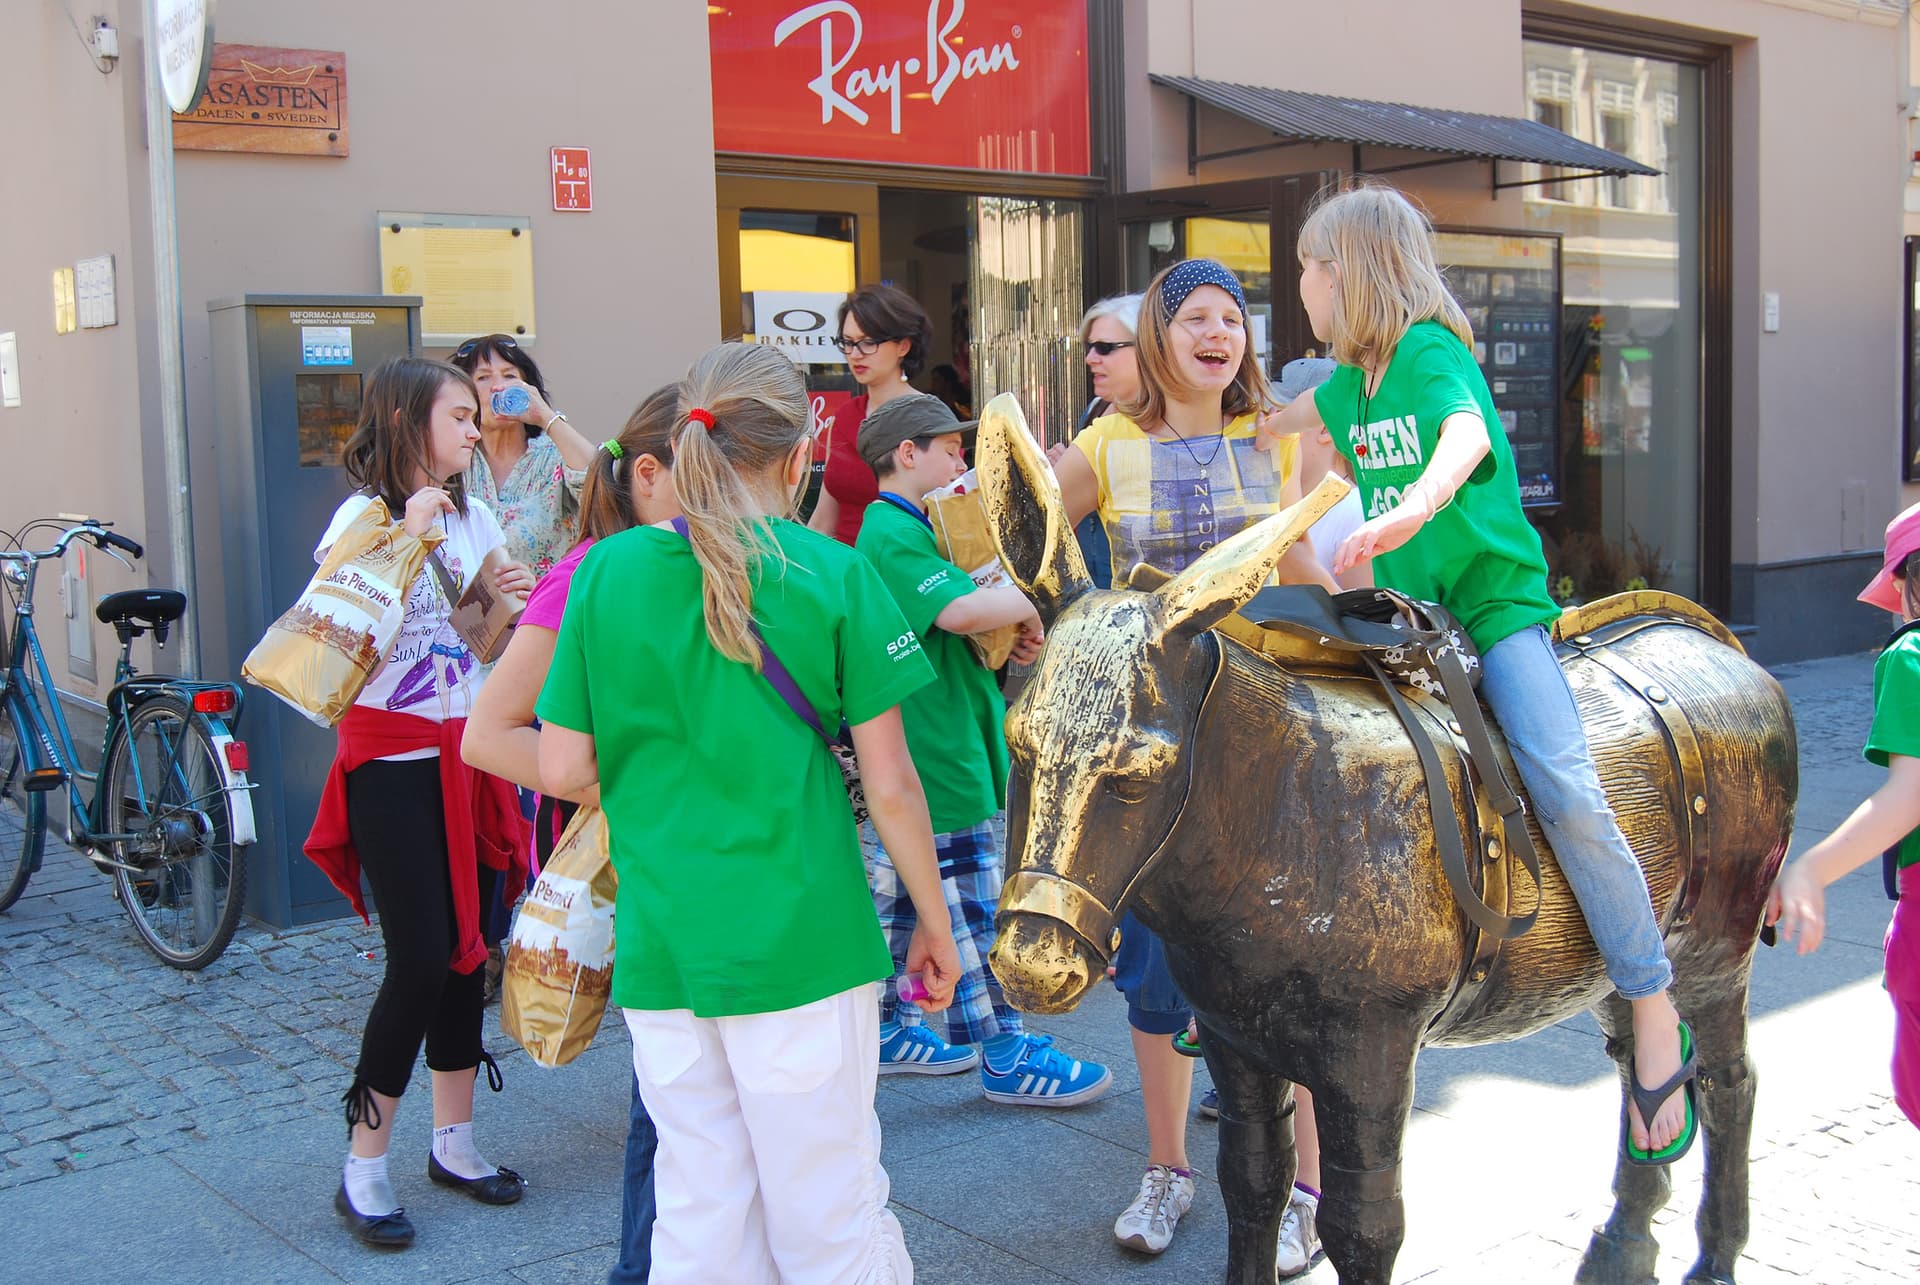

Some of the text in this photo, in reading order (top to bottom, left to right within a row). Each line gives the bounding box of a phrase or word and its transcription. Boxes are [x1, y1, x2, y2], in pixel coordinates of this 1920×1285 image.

[202, 83, 328, 110] ASASTEN
[267, 113, 328, 124] SWEDEN
[289, 311, 376, 319] INFORMACJA MIEJSKA
[916, 569, 948, 593] SONY
[886, 631, 916, 655] SON
